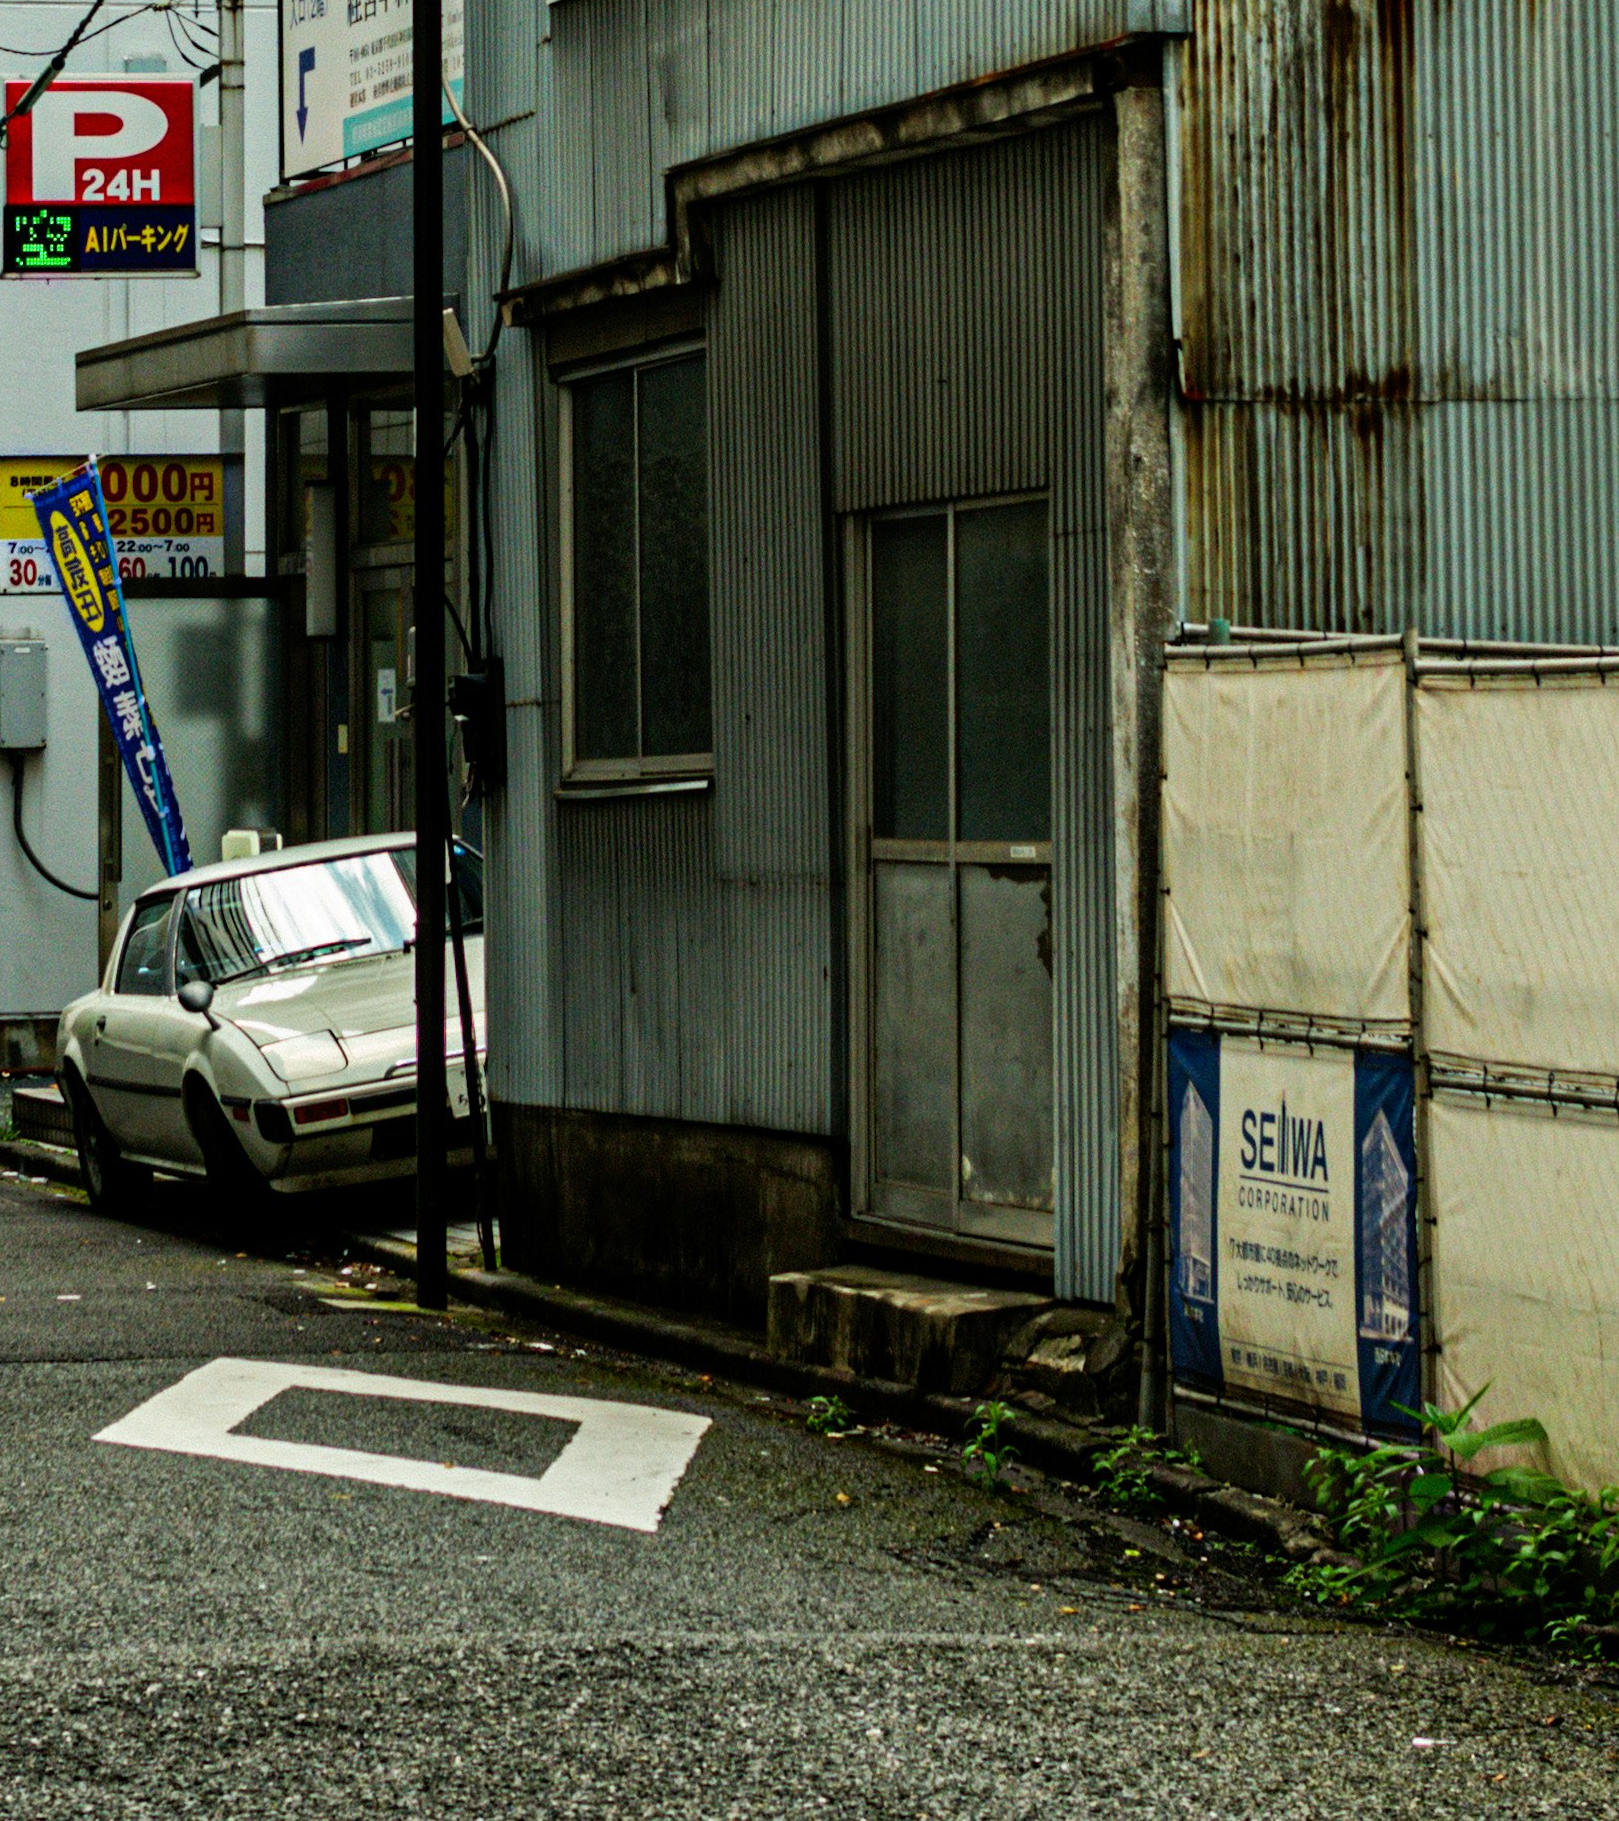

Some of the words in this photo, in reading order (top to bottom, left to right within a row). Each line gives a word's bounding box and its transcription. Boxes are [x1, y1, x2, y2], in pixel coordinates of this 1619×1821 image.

[32, 90, 170, 201] P
[82, 167, 161, 202] 24H
[84, 222, 190, 254] AIパーキング
[72, 462, 214, 503] 000円
[1240, 1090, 1328, 1182] SEIWA
[1238, 1185, 1329, 1222] CORPORATION
